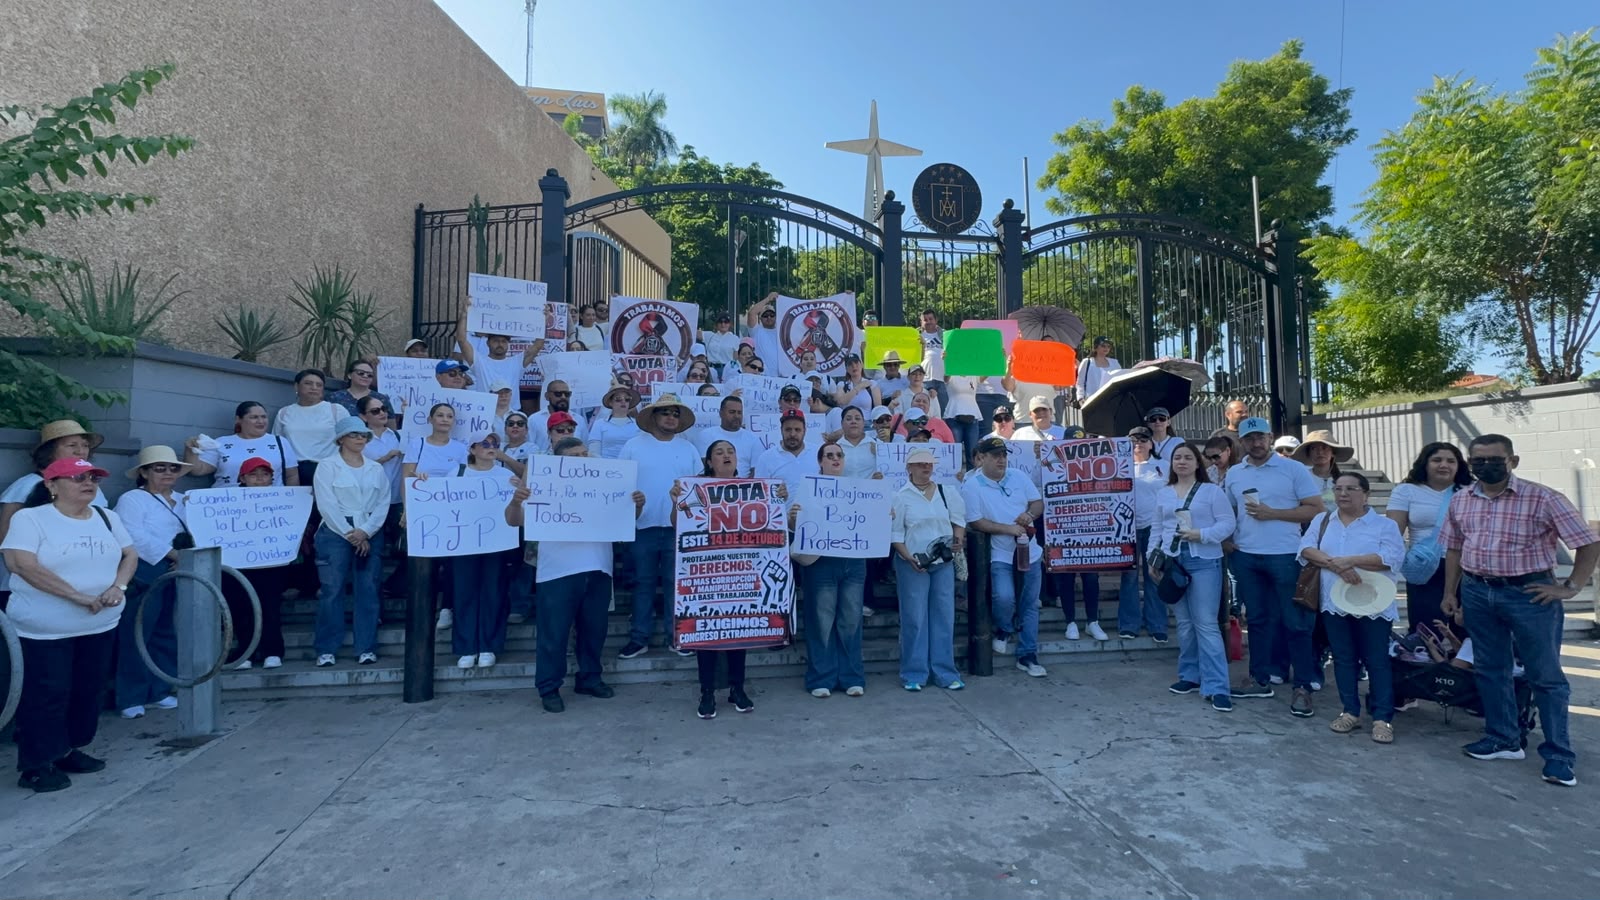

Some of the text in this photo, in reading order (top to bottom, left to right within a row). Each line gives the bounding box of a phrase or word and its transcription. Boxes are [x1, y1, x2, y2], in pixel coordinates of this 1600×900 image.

[557, 93, 599, 114] Luis
[469, 275, 500, 293] Todos
[526, 283, 545, 297] IMSS
[624, 304, 685, 328] TRABAJAMOS
[789, 303, 844, 318] TRABAJAMOS
[419, 359, 436, 370] Luch
[628, 357, 663, 370] VOTA
[787, 347, 849, 373] BAJ ROTESTA
[630, 370, 665, 386] NO
[763, 378, 772, 390] 14
[408, 387, 426, 408] No
[754, 390, 768, 402] NO
[470, 415, 489, 433] No
[1063, 439, 1115, 461] VOTA
[531, 455, 624, 479] La Lucha es
[1066, 456, 1117, 483] NO
[411, 478, 478, 503] Salario
[529, 482, 542, 496] Por
[565, 484, 577, 498] Por
[583, 488, 597, 499] mi
[602, 493, 610, 505] y
[612, 490, 627, 503] por
[706, 482, 766, 505] VOTA
[804, 476, 884, 506] Trabajamos
[1047, 478, 1132, 495] ESTE 14 DE OCTUBRE
[189, 489, 238, 506] Cuando
[284, 488, 295, 497] el
[254, 503, 294, 514] Empieza
[526, 501, 584, 524] Todos.
[708, 501, 770, 533] NO
[823, 503, 867, 531] Bajo
[215, 520, 228, 531] la
[209, 536, 255, 549] Base
[263, 535, 278, 544] no
[682, 531, 785, 548] ESTE 14 DE OCTUBRE
[798, 520, 869, 551] Protesta
[681, 551, 761, 564] PROTEJAMOS NUESTROS
[1050, 553, 1134, 566] CONGRESO EXTRAORDINARIO
[1061, 546, 1122, 558] EXIGIMOS
[689, 560, 755, 577] DERECHOS.
[681, 578, 693, 587] NO
[698, 593, 715, 601] BASE
[717, 591, 762, 600] TRABAJADORA
[695, 616, 770, 632] EXIGIMOS
[679, 627, 784, 644] CONGRESO EXTRAORDINARIO
